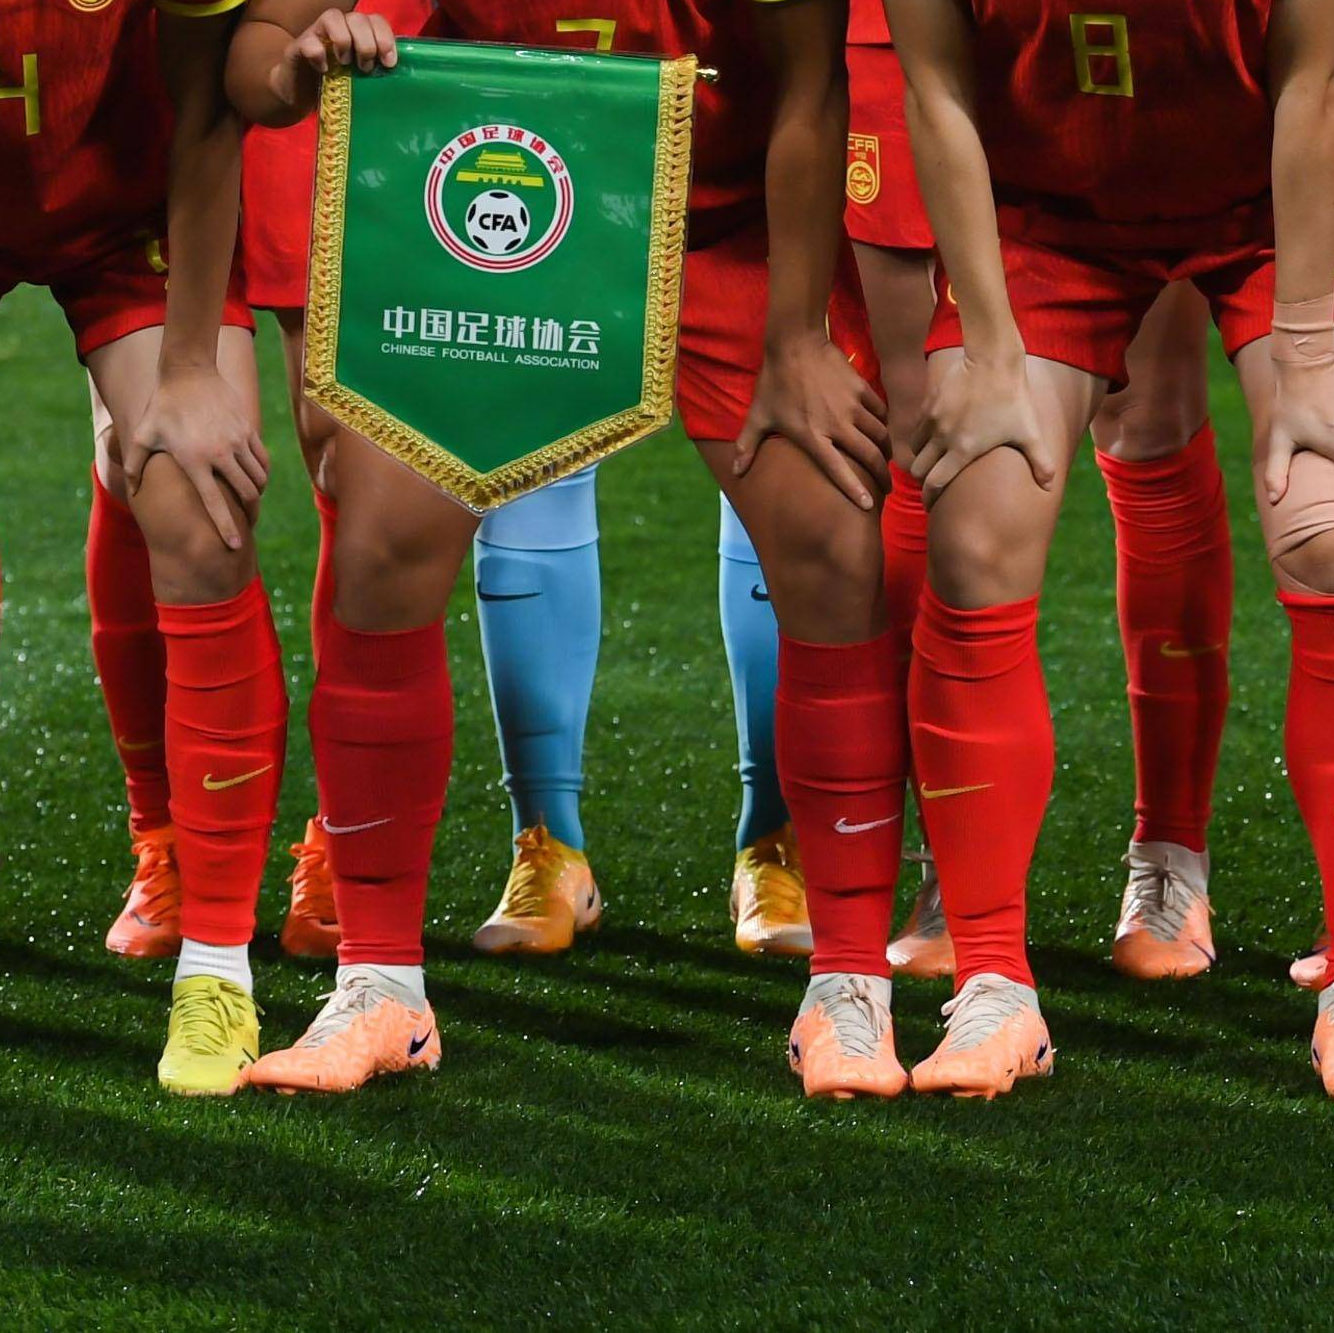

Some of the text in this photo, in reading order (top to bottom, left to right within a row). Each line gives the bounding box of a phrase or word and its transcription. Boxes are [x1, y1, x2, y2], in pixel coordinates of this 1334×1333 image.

[1069, 13, 1134, 98] 8
[438, 126, 565, 175] 中国足球协会
[478, 213, 518, 233] CFA
[382, 305, 601, 355] 中国足球协会
[380, 342, 600, 371] CHINESE FOOTBALL ASSOCIATION
